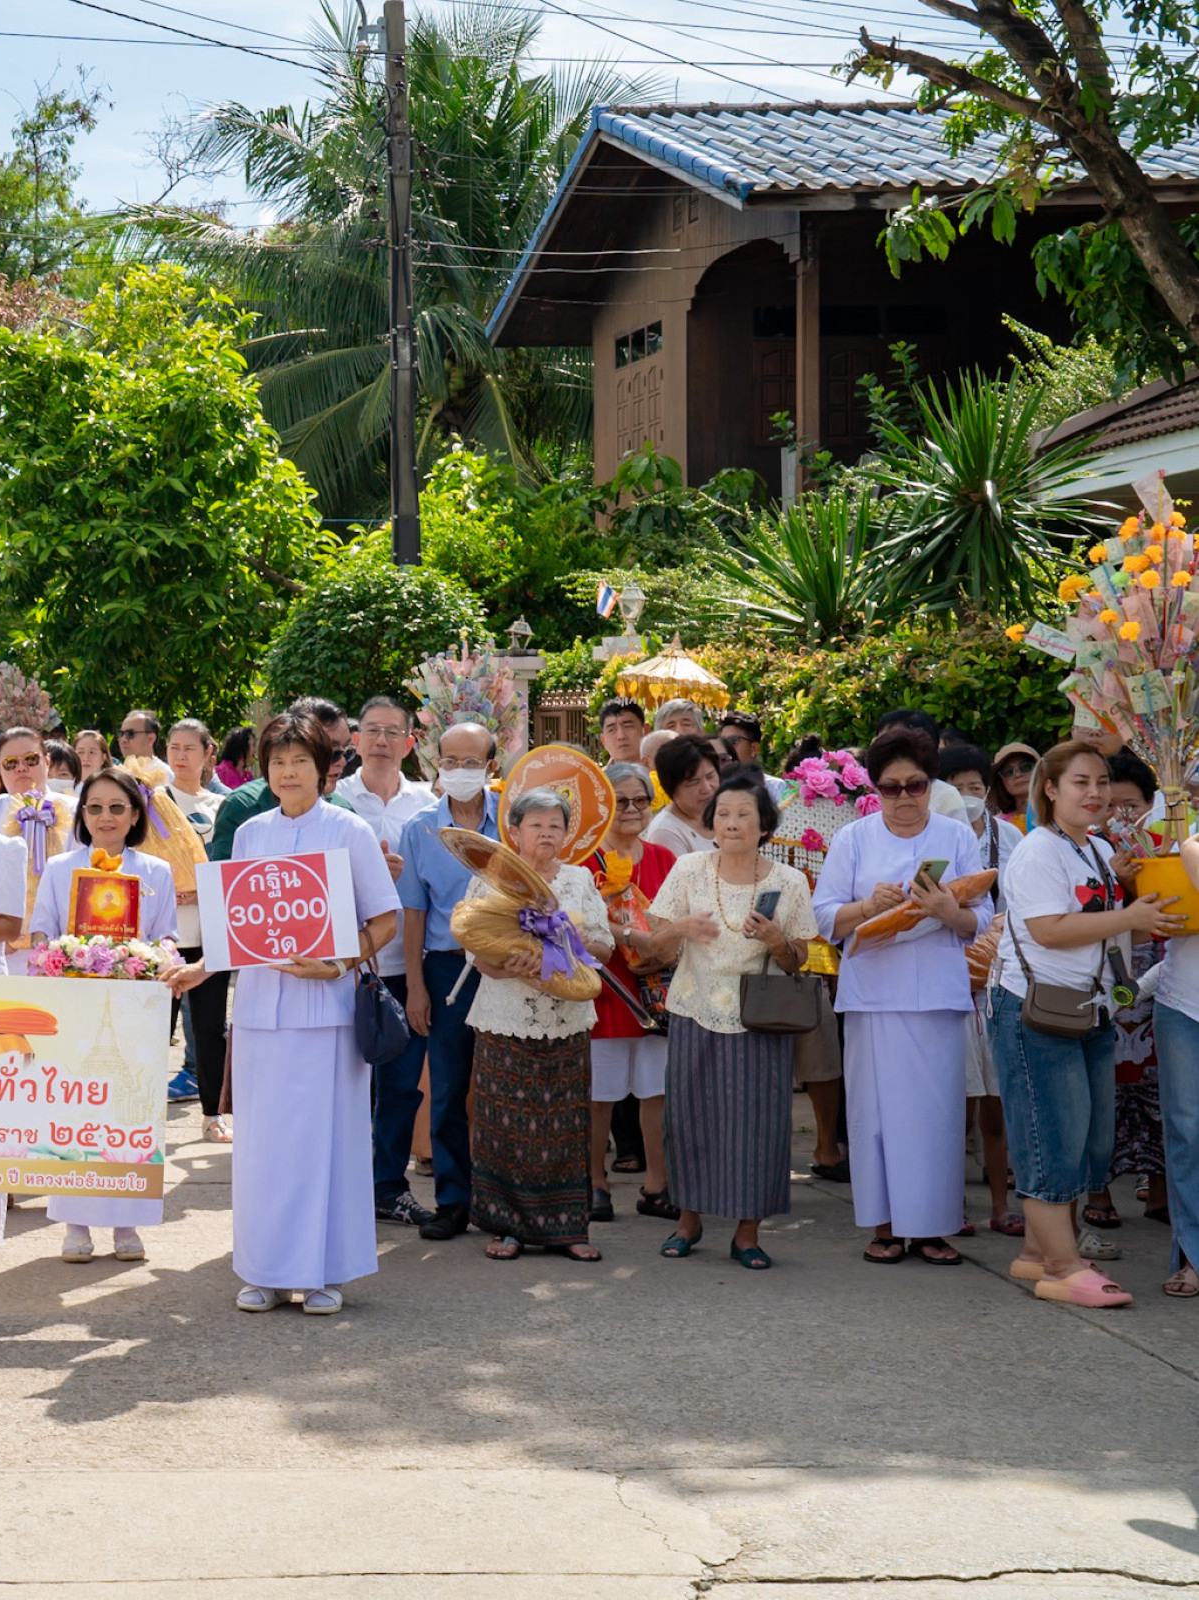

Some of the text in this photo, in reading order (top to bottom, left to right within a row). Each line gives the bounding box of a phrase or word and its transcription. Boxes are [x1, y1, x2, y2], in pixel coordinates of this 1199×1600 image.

[249, 863, 302, 898] กฐิน
[230, 897, 326, 927] 30,000
[265, 928, 297, 955] วัด
[49, 1119, 153, 1150] ๒๕๖๘
[8, 1169, 19, 1184] ปี
